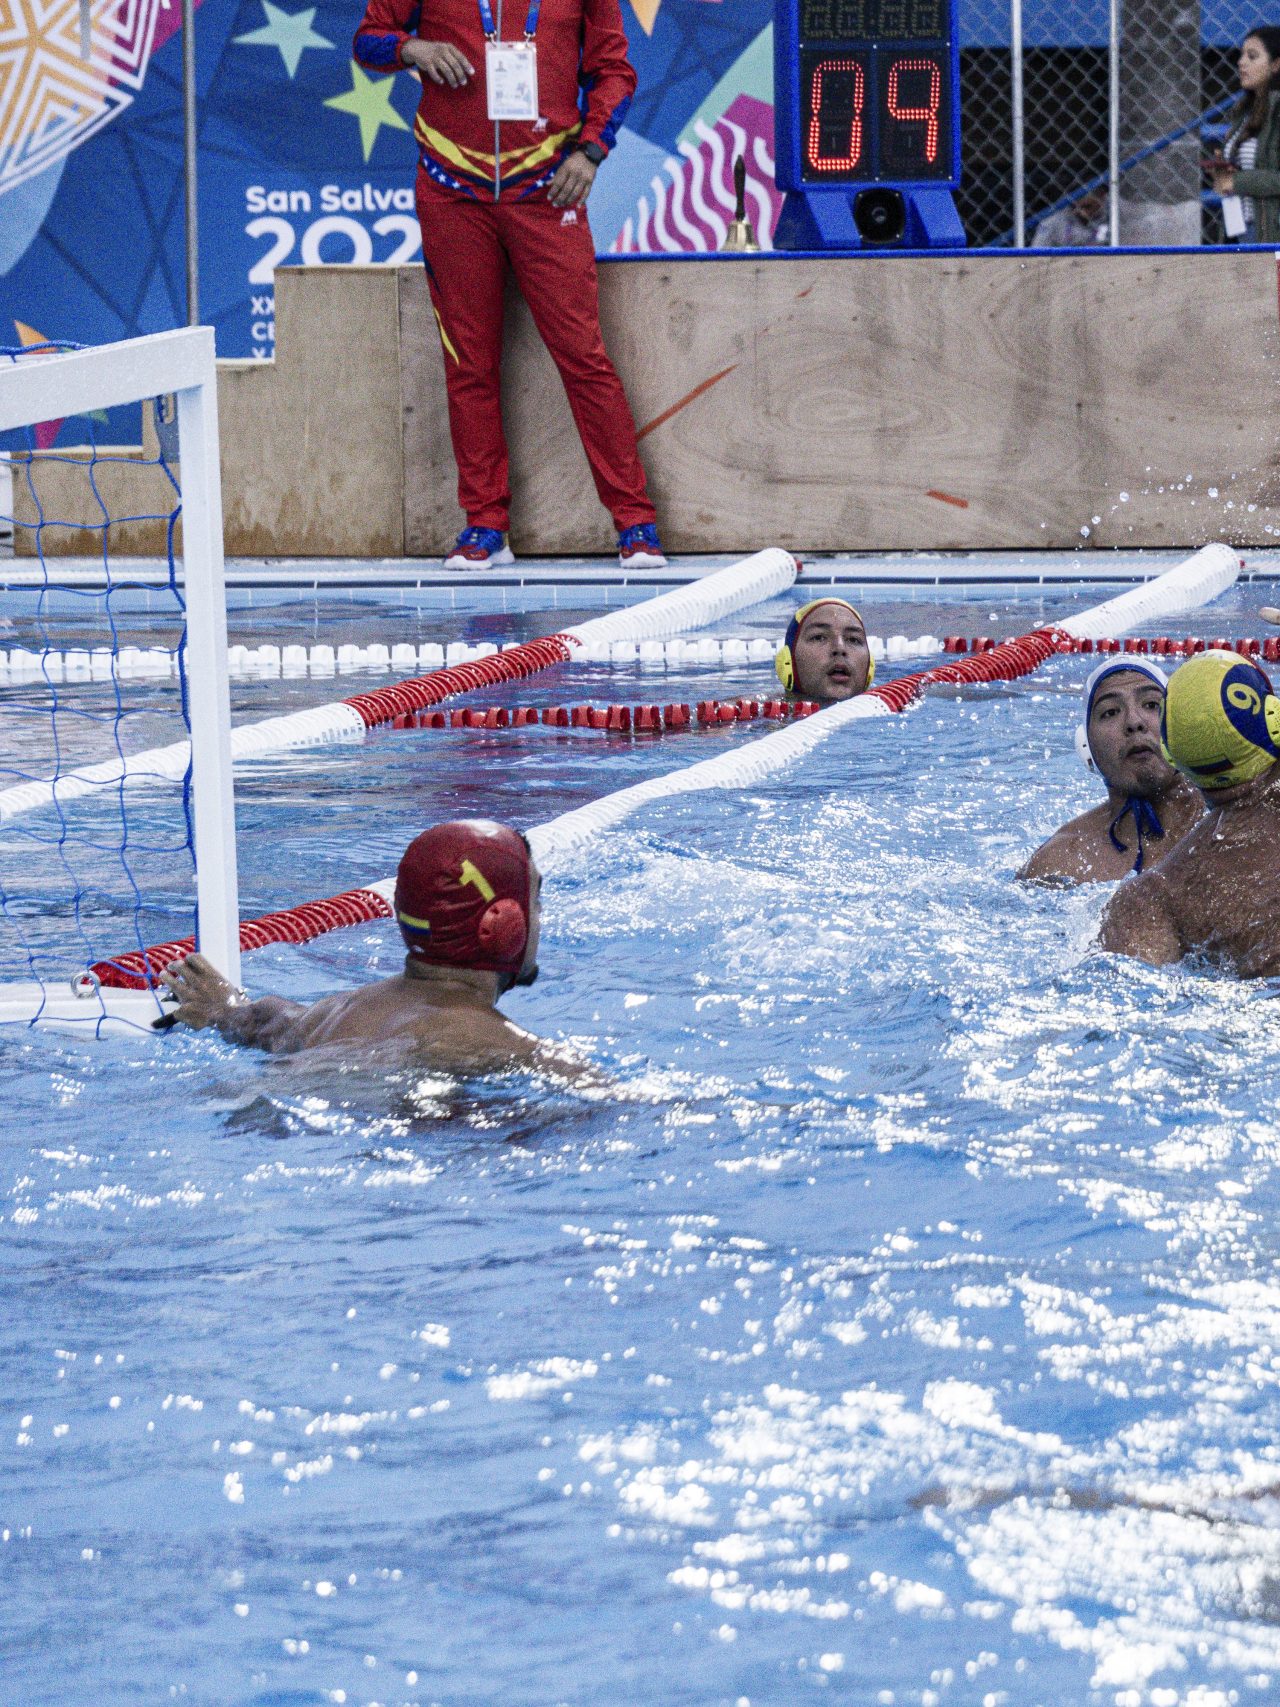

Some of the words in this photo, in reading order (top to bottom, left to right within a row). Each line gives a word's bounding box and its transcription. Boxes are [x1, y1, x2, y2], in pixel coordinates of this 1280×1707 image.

[808, 60, 941, 172] 09
[246, 185, 312, 213] San
[1226, 682, 1261, 715] 9
[459, 859, 496, 903] 1
